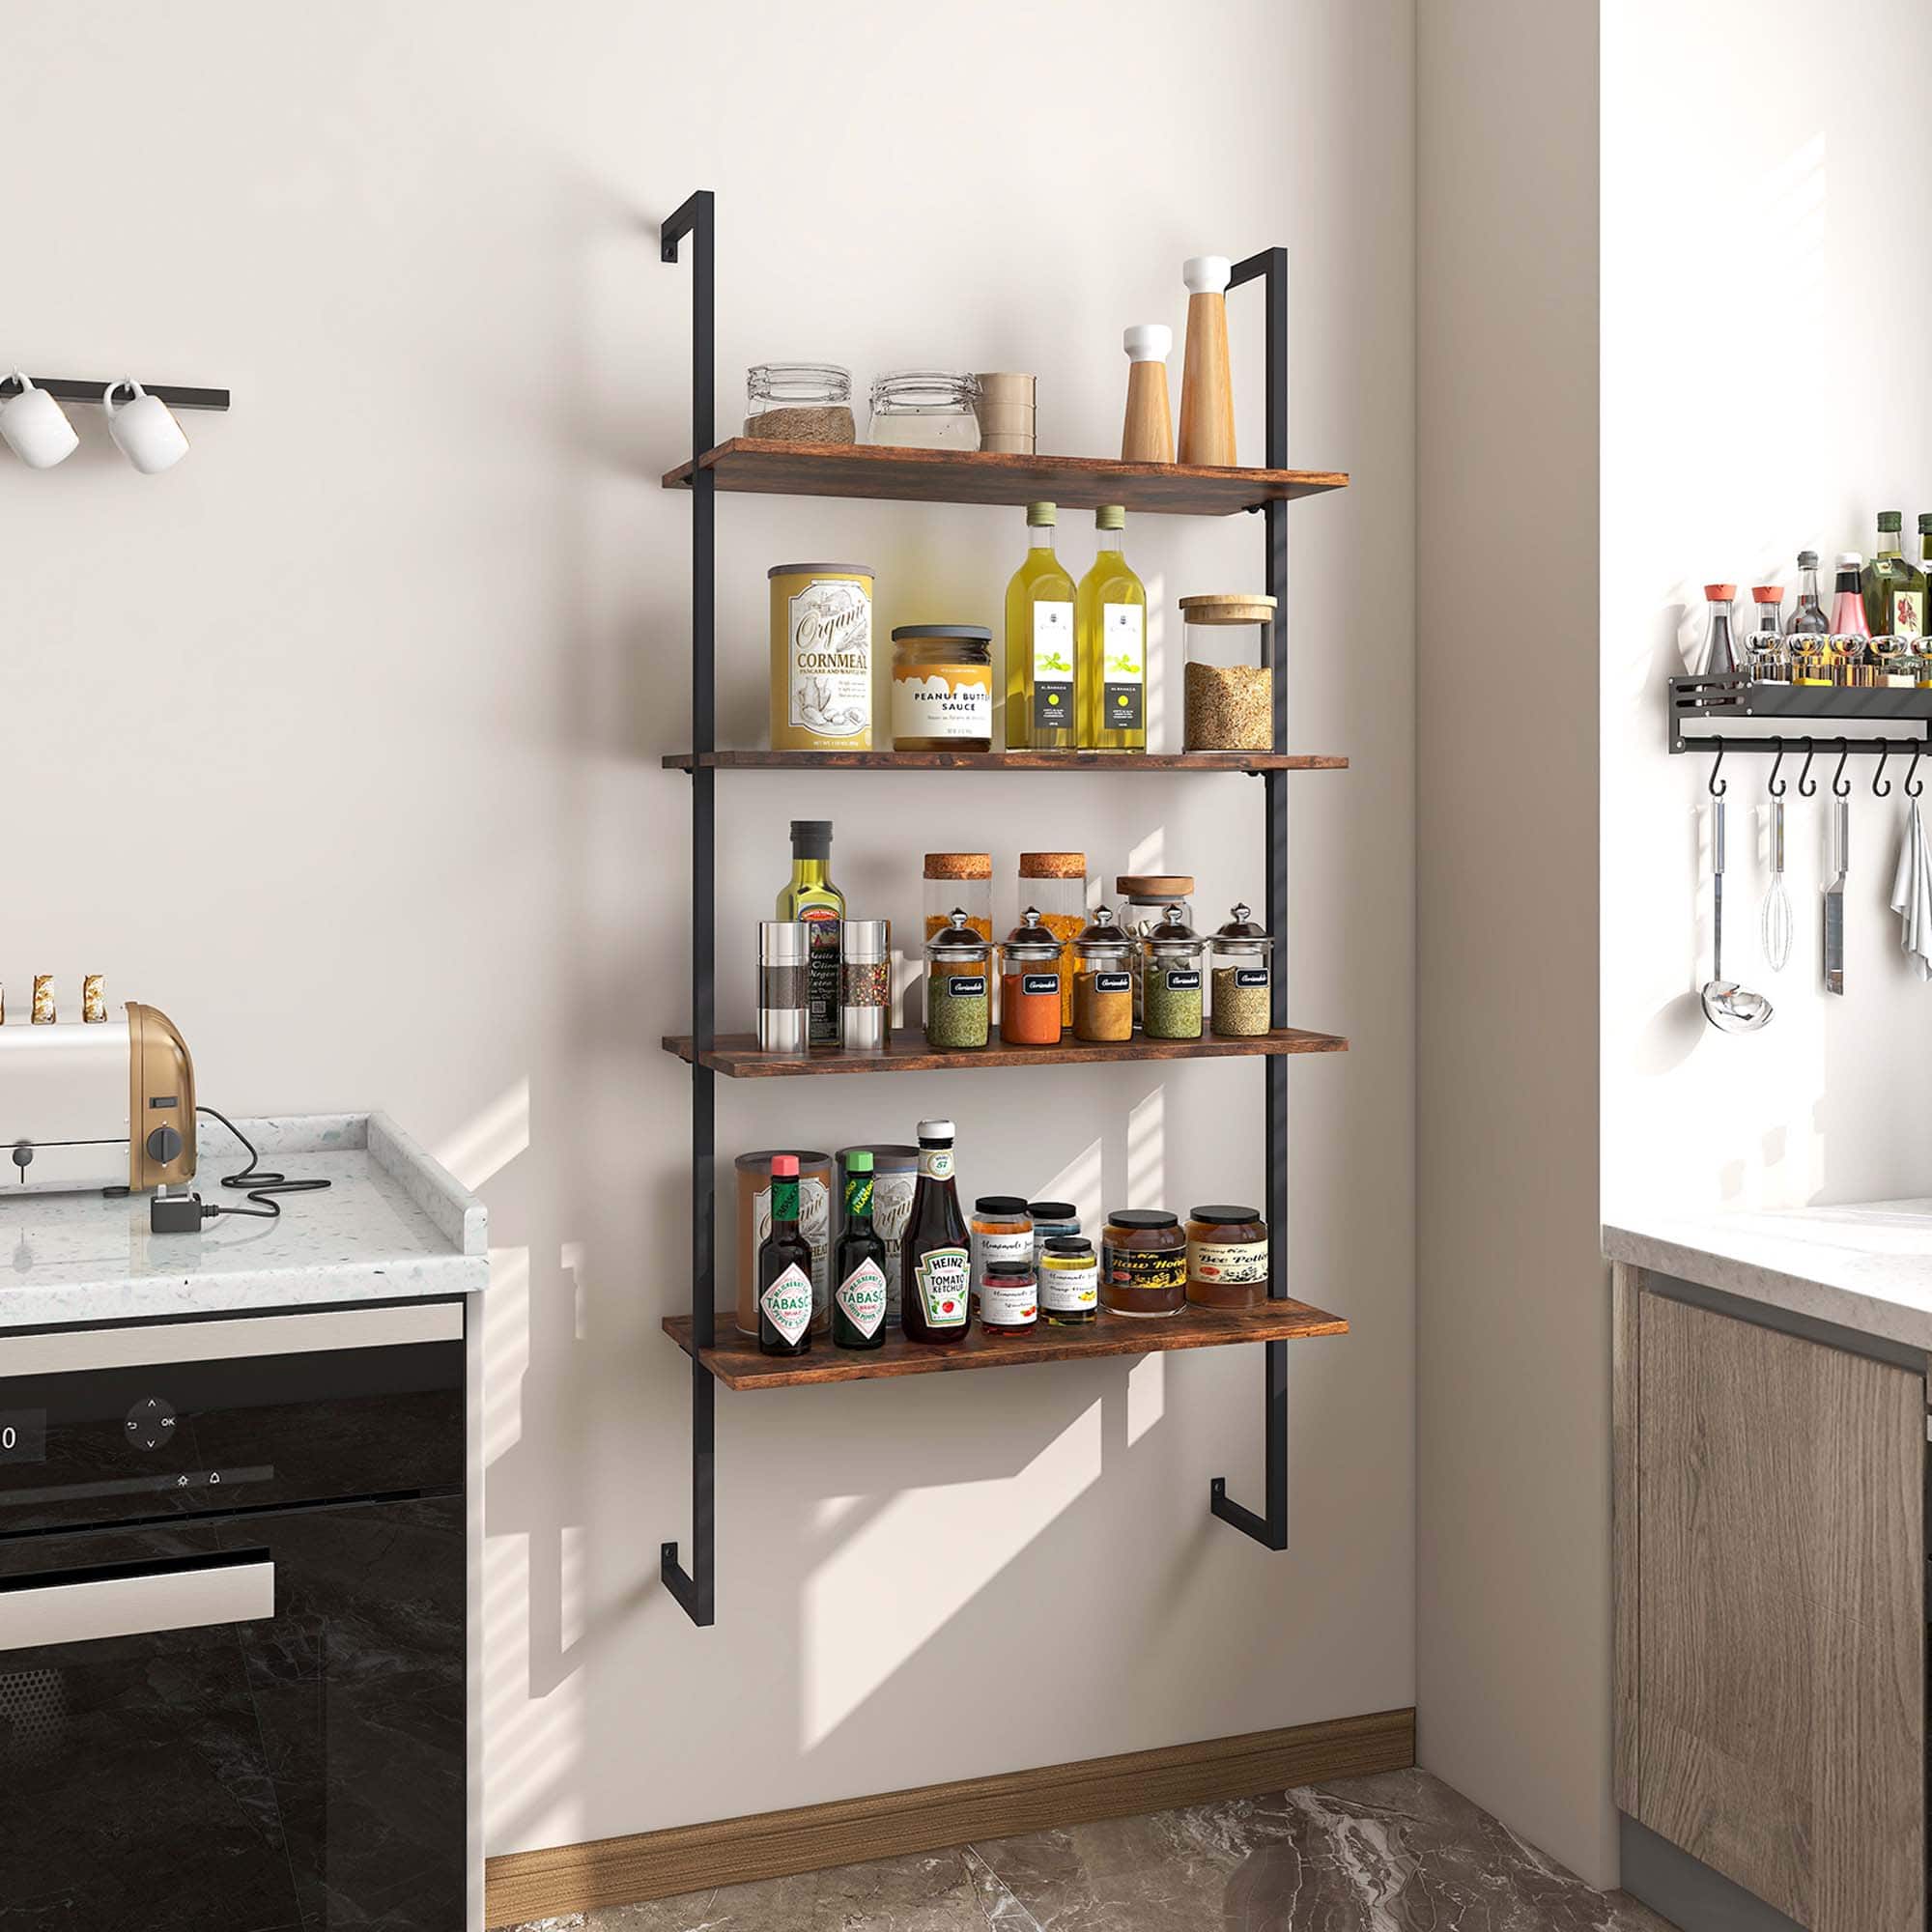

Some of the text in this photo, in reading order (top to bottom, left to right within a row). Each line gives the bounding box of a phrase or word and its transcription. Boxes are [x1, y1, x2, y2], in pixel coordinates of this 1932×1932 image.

[932, 1257, 964, 1270] HEINZ
[930, 1273, 965, 1287] TOMATO
[766, 1296, 809, 1310] TABASC
[842, 1290, 884, 1304] TABASC
[160, 1416, 176, 1427] OK
[2, 1426, 16, 1449] 0
